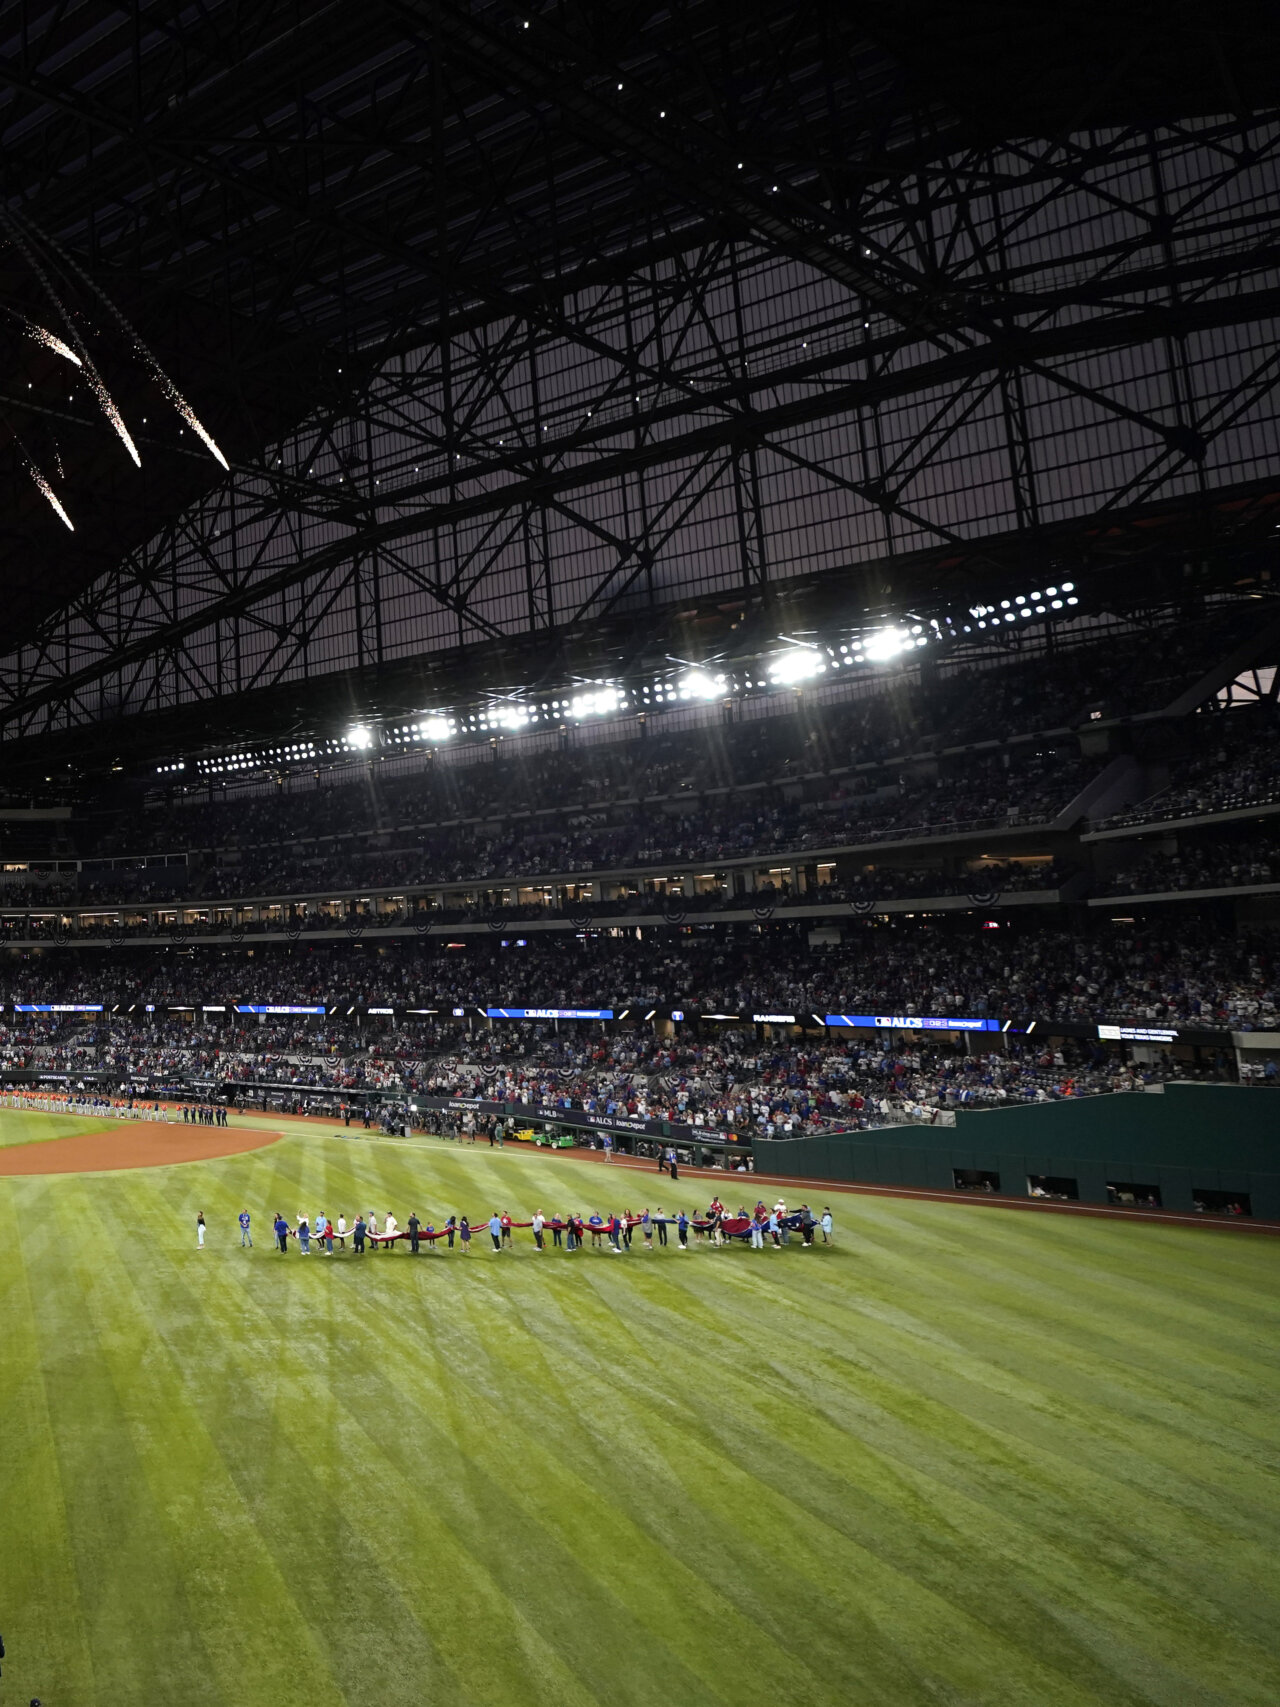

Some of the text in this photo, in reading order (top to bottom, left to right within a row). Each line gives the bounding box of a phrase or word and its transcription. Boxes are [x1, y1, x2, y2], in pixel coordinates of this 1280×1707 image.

[536, 1009, 559, 1018] ALCS
[754, 1015, 795, 1023] RANGERS
[892, 1017, 923, 1028] ALCS
[923, 1018, 947, 1028] 2023
[448, 1101, 480, 1110] loanDepot
[544, 1110, 557, 1118] MLB
[595, 1117, 646, 1130] ALCS loanDepot
